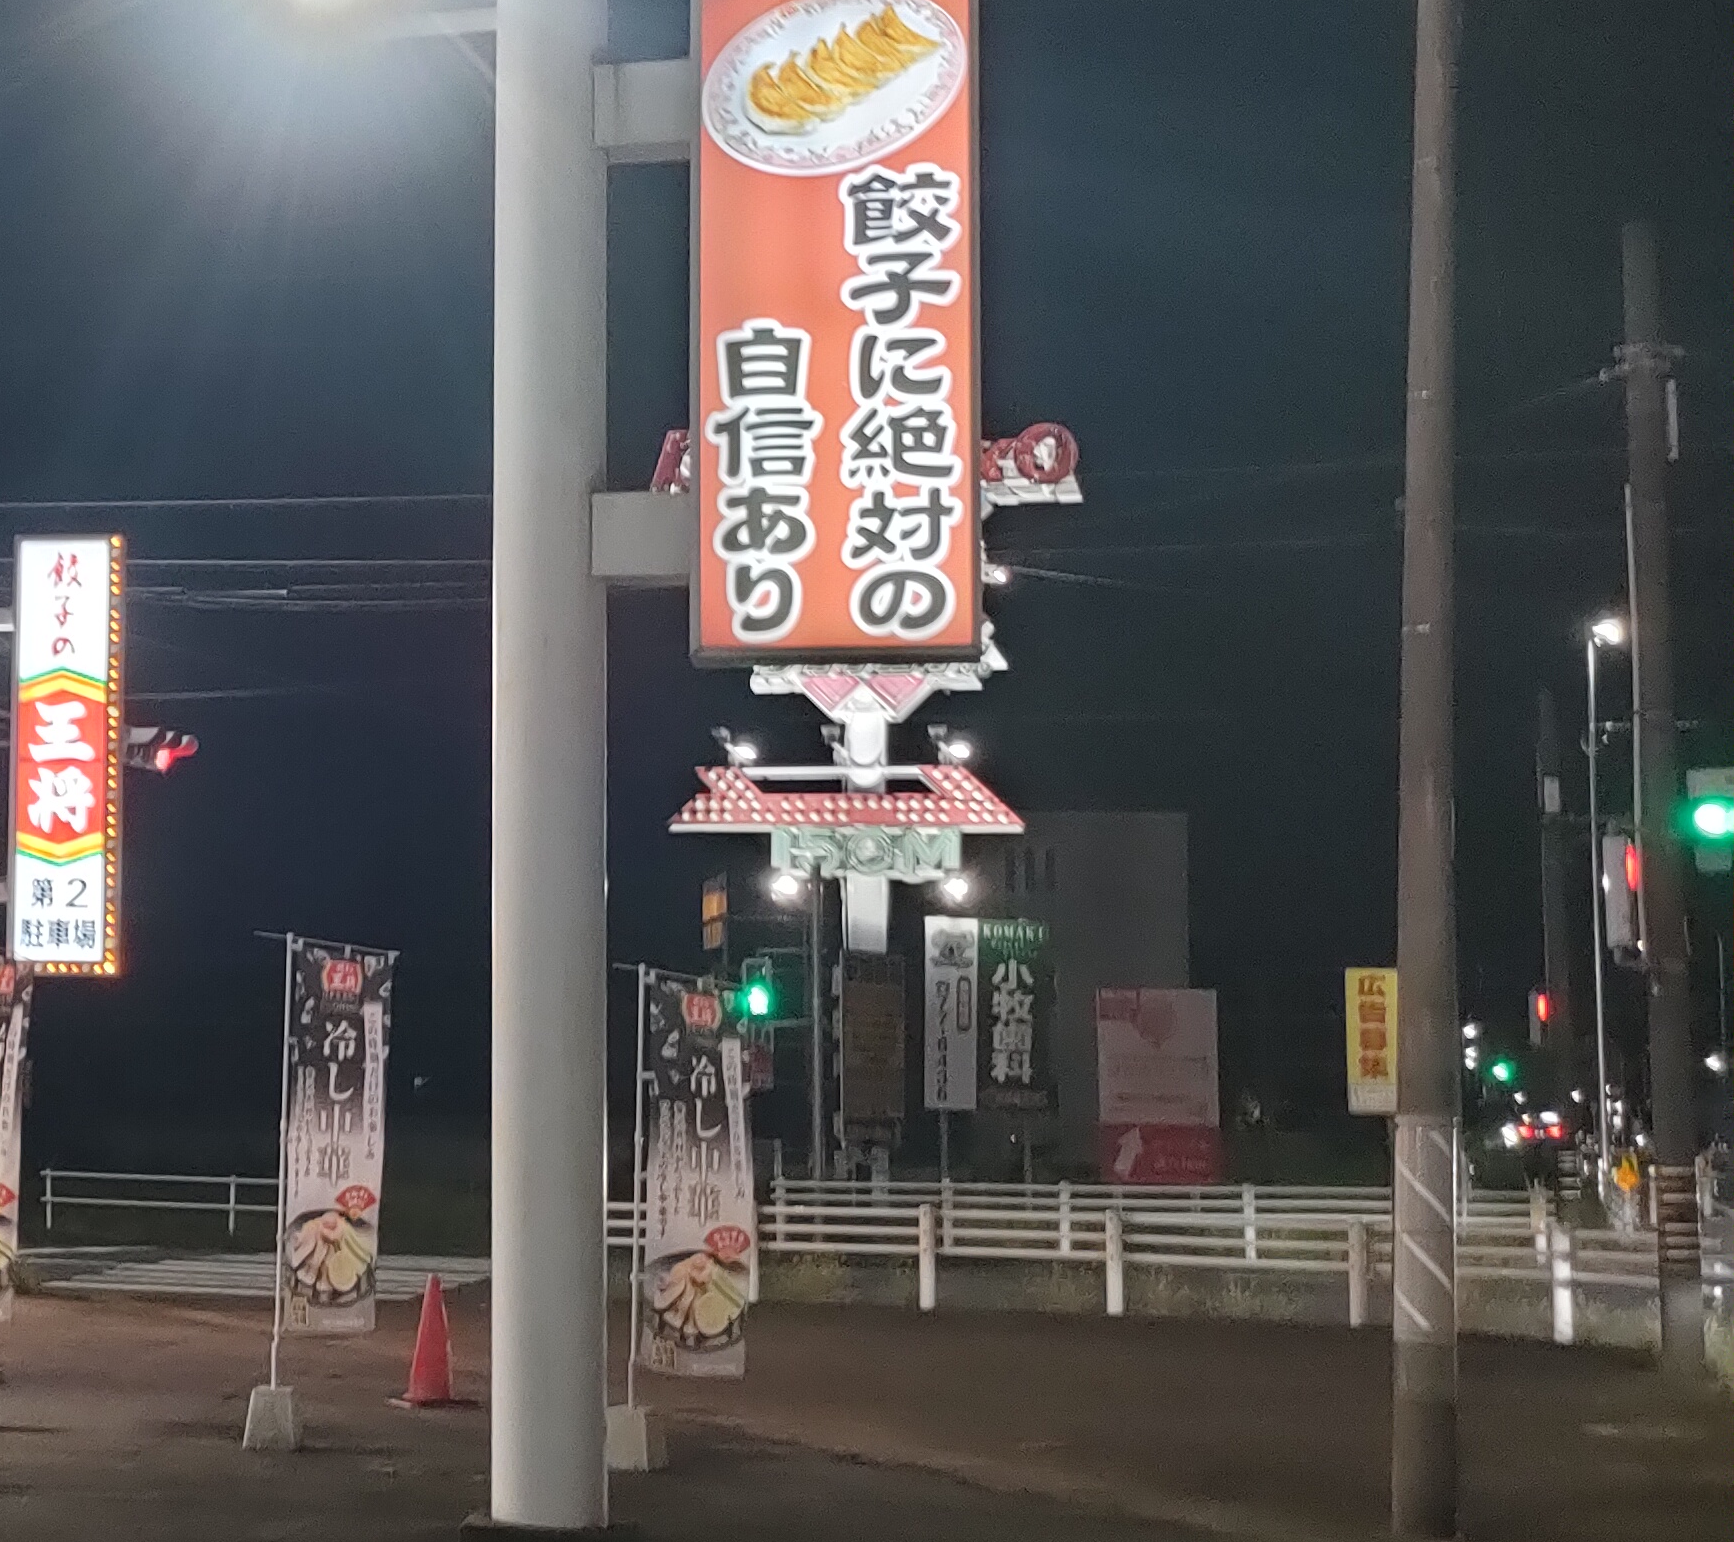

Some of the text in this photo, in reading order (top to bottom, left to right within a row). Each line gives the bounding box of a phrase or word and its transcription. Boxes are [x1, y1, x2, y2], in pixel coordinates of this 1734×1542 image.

[844, 168, 957, 635] 餃子に絶対の
[711, 323, 818, 638] 自信あり
[47, 550, 82, 657] 餃子の
[27, 701, 96, 834] 王将
[20, 918, 96, 949] 駐車場
[31, 877, 88, 908] 第2
